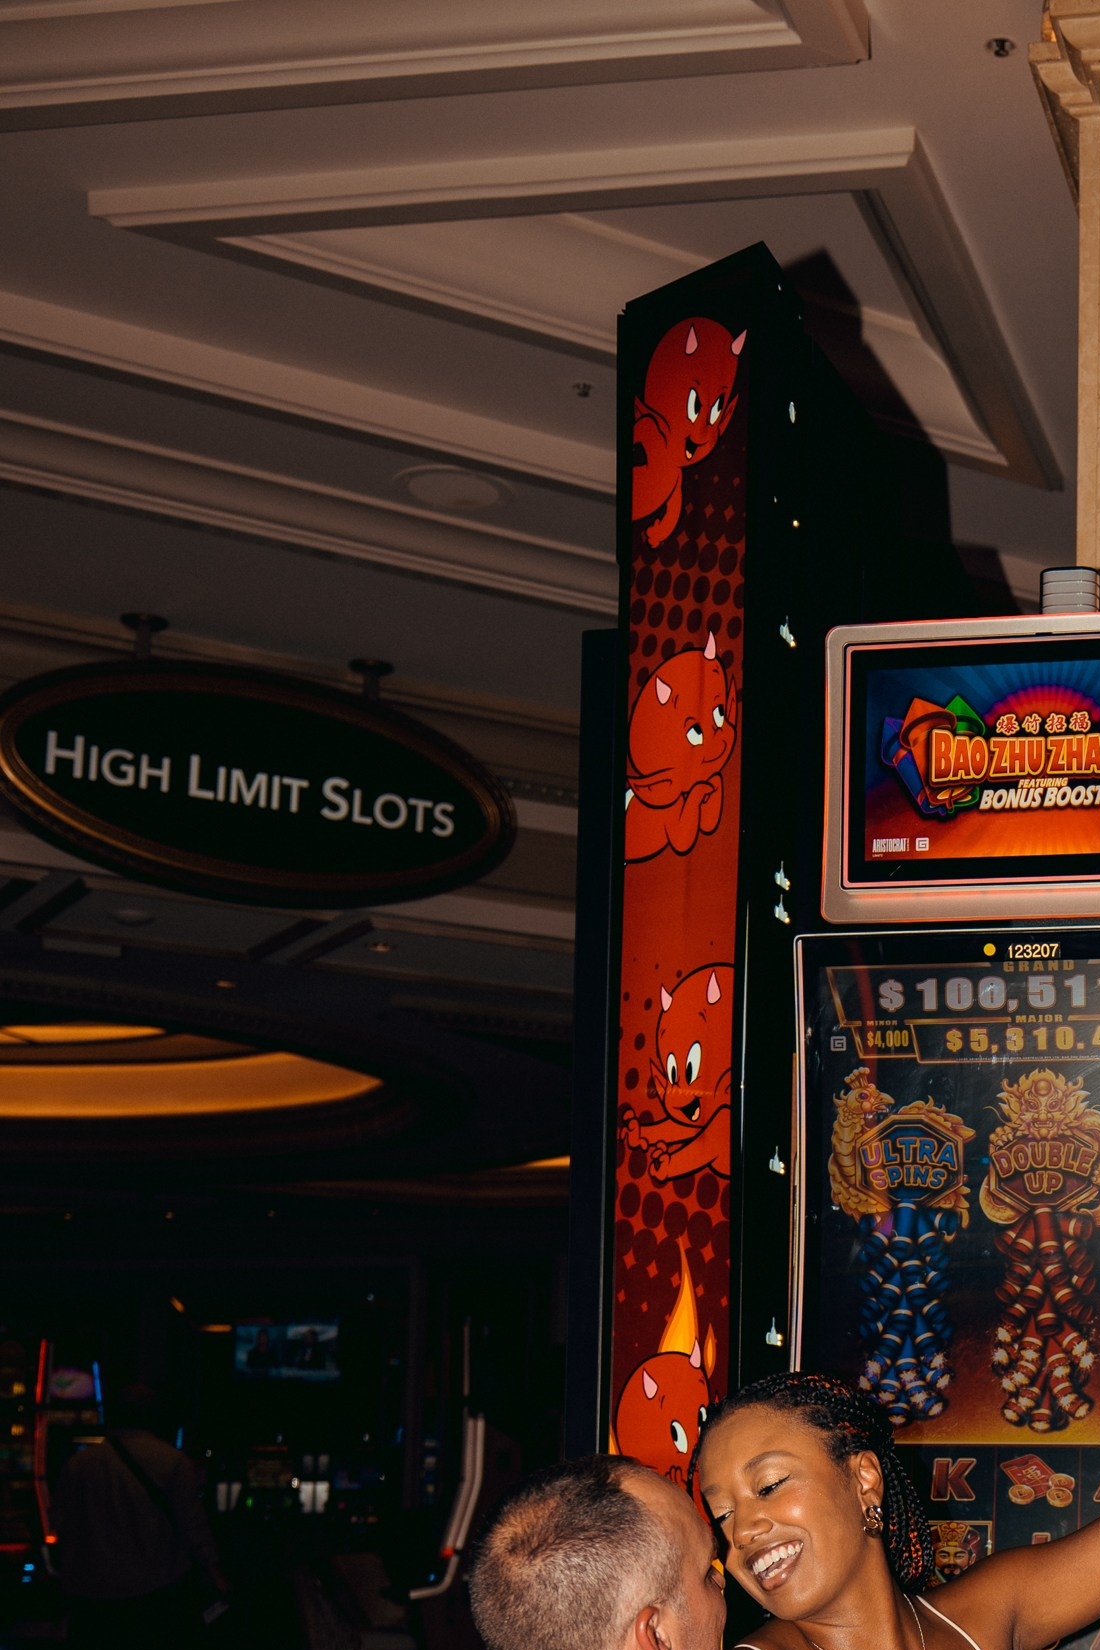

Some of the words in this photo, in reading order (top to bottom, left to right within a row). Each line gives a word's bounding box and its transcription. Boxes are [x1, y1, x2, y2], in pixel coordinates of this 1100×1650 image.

[931, 728, 988, 783] BAO
[989, 737, 1046, 777] ZHU
[45, 731, 171, 793] HIGH
[188, 755, 309, 813] LIMIT
[320, 777, 455, 837] SLOTS
[1018, 777, 1068, 789] FEATURING
[979, 788, 1044, 810] BONUS
[1007, 943, 1059, 959] 123207
[1003, 960, 1075, 973] GRAND
[1016, 1014, 1063, 1024] MAJOR
[867, 1030, 909, 1049] $4,000
[861, 1136, 958, 1171] ULTRA
[992, 1141, 1098, 1178] DOUBLE
[869, 1164, 947, 1190] SPINS
[1024, 1170, 1063, 1195] UP
[931, 1458, 977, 1501] K
